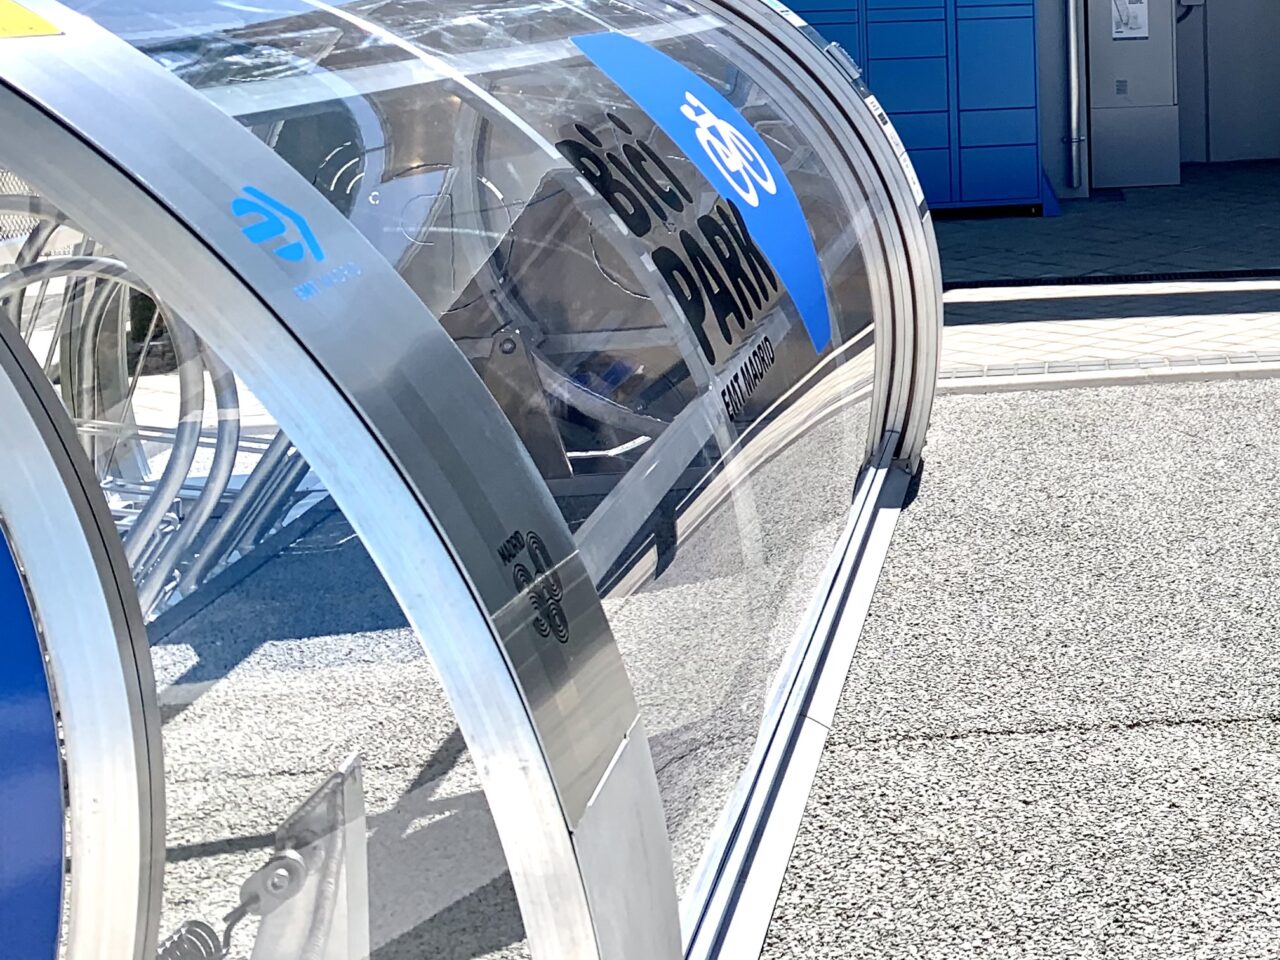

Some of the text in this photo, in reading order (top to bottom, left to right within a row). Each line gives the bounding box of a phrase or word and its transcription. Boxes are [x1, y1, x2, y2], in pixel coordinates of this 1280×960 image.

[651, 197, 779, 366] PARK
[720, 335, 776, 423] EMT MADRID
